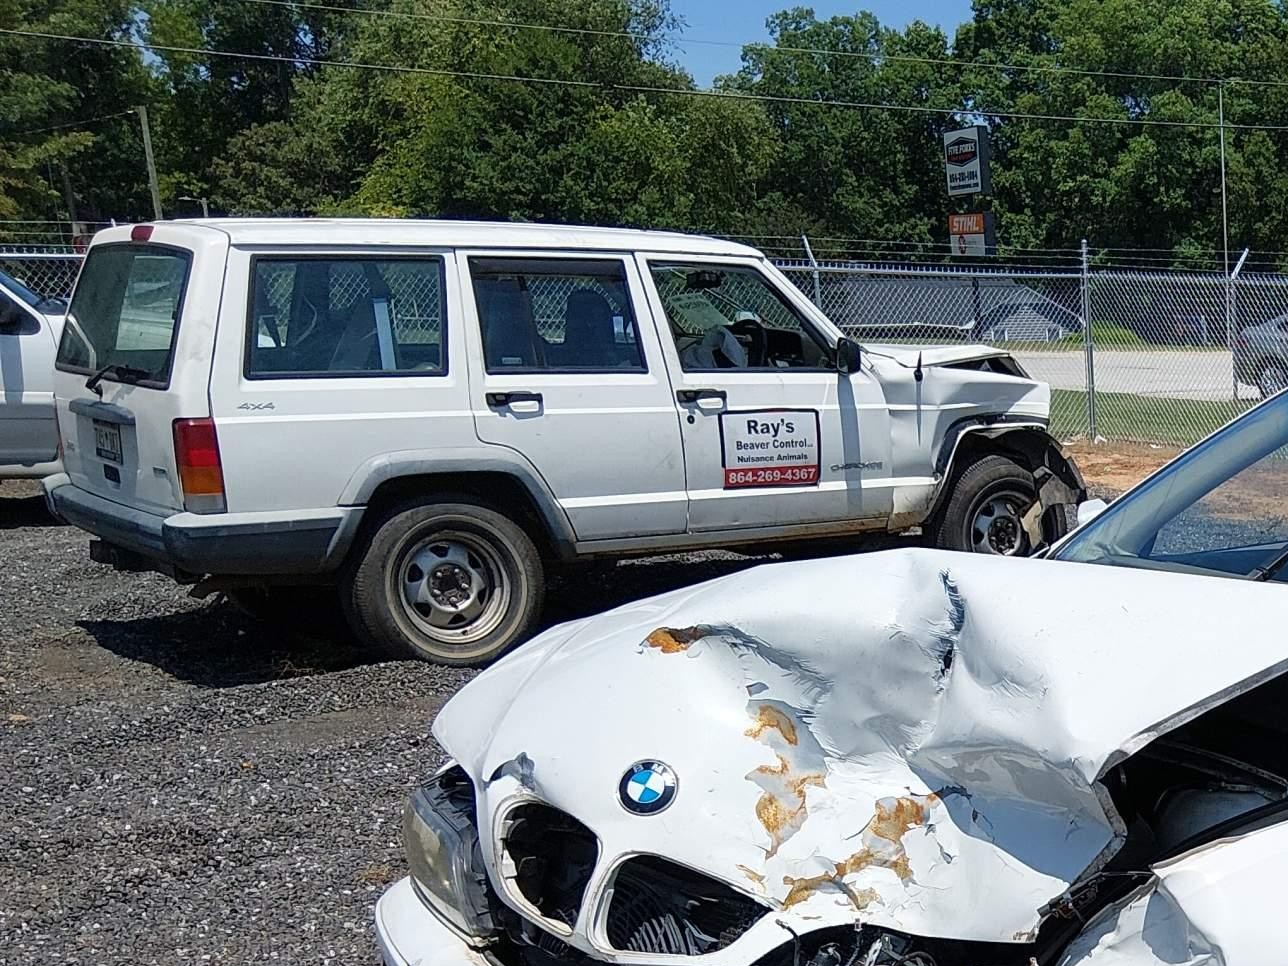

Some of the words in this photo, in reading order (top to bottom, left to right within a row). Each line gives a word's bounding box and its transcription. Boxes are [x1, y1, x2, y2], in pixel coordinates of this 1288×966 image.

[959, 143, 975, 153] FORKS
[952, 215, 979, 231] STIHL
[747, 418, 795, 438] Ray's
[736, 440, 770, 451] Beaver
[772, 438, 807, 449] Control
[737, 454, 774, 463] Nuisance
[777, 453, 809, 461] Animals
[728, 468, 817, 485] 864-269-4367
